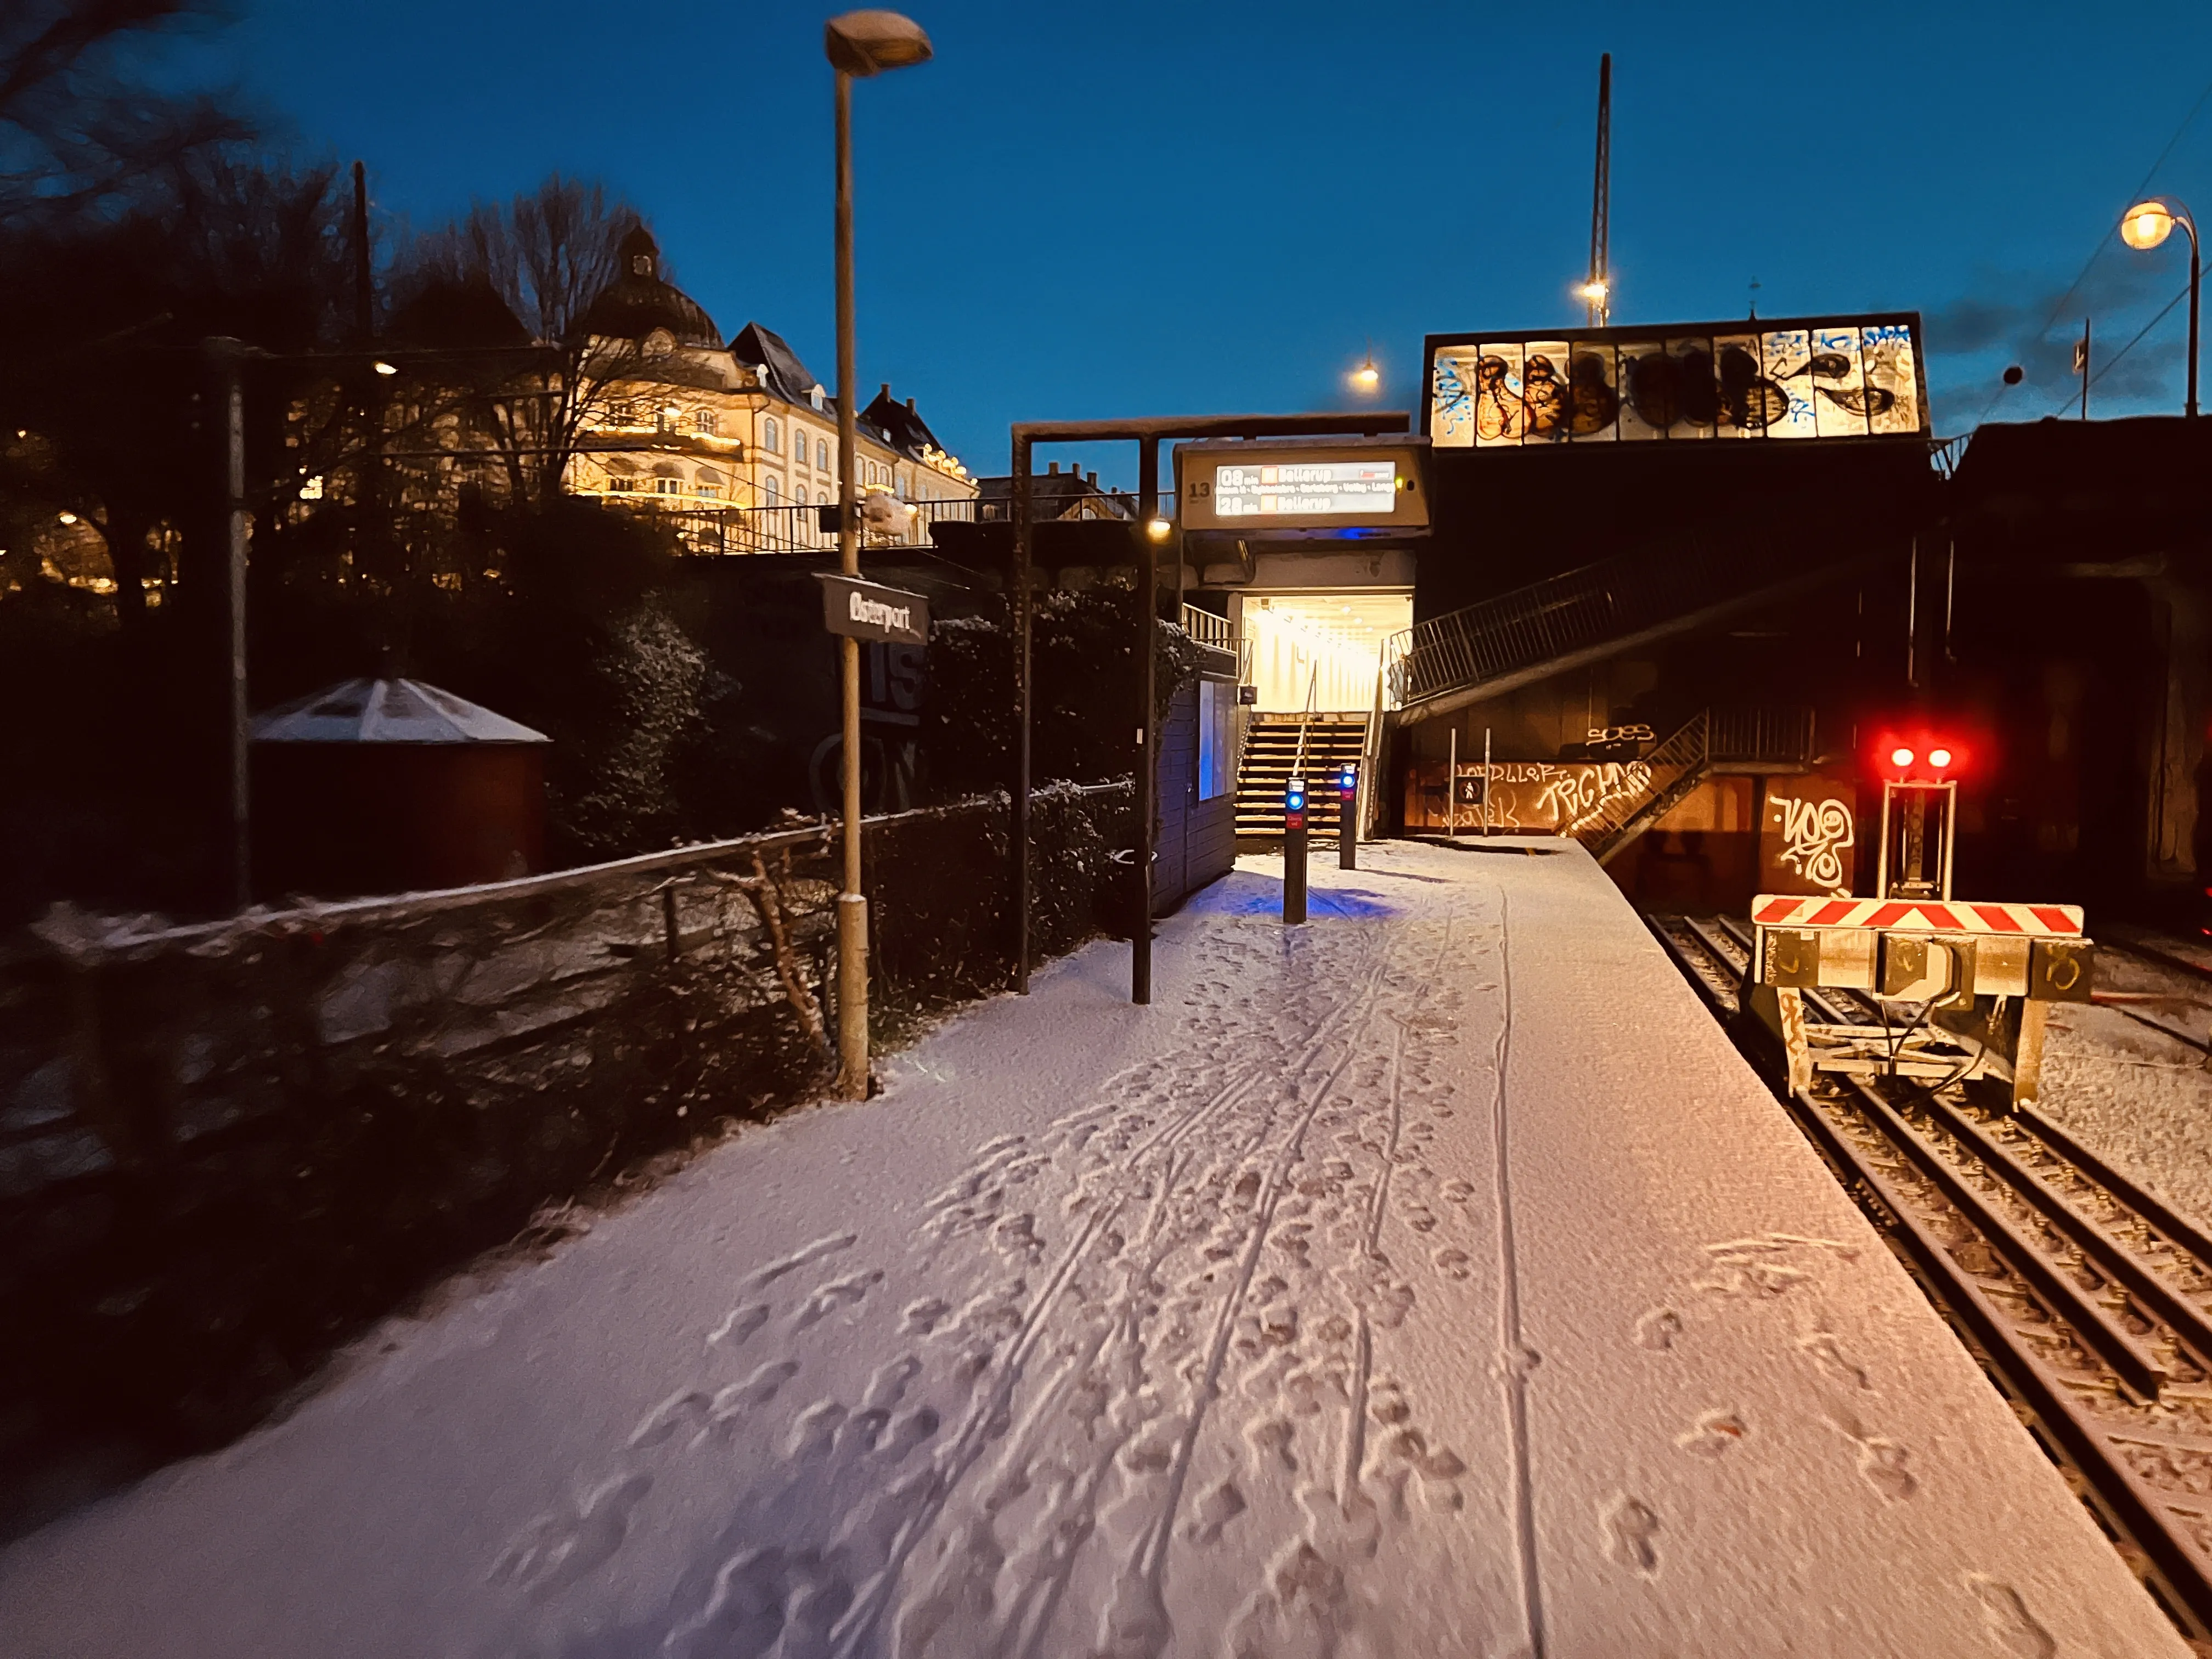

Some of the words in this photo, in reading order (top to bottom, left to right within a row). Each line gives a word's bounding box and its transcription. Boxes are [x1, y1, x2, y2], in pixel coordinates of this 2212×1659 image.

[1221, 470, 1244, 486] 08
[1189, 482, 1210, 498] 13
[1221, 497, 1243, 515] 28
[849, 591, 911, 633] Østerport
